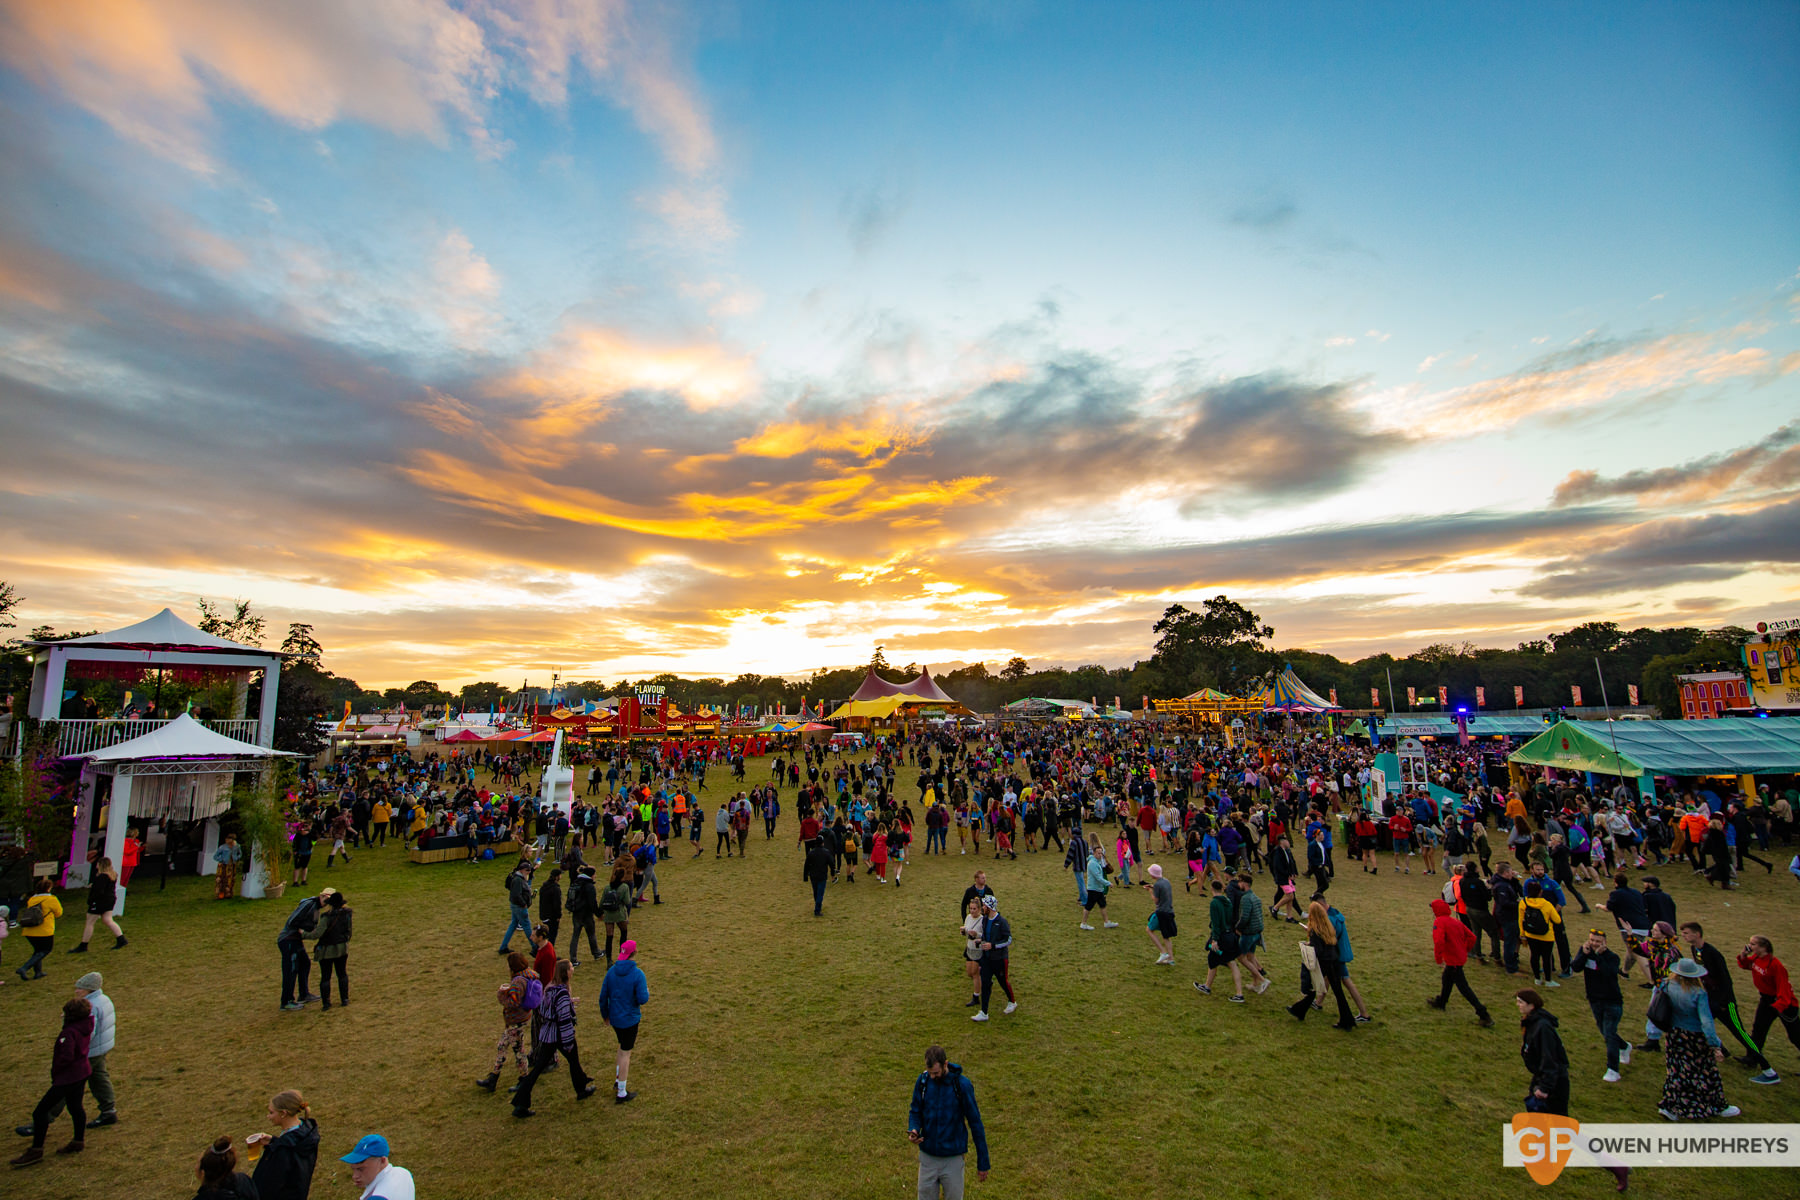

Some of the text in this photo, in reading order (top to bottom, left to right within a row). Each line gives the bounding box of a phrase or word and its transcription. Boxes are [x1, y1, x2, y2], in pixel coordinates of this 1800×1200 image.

[634, 685, 666, 694] FLAVOUR
[637, 694, 663, 705] VILLE
[730, 737, 771, 757] EAT
